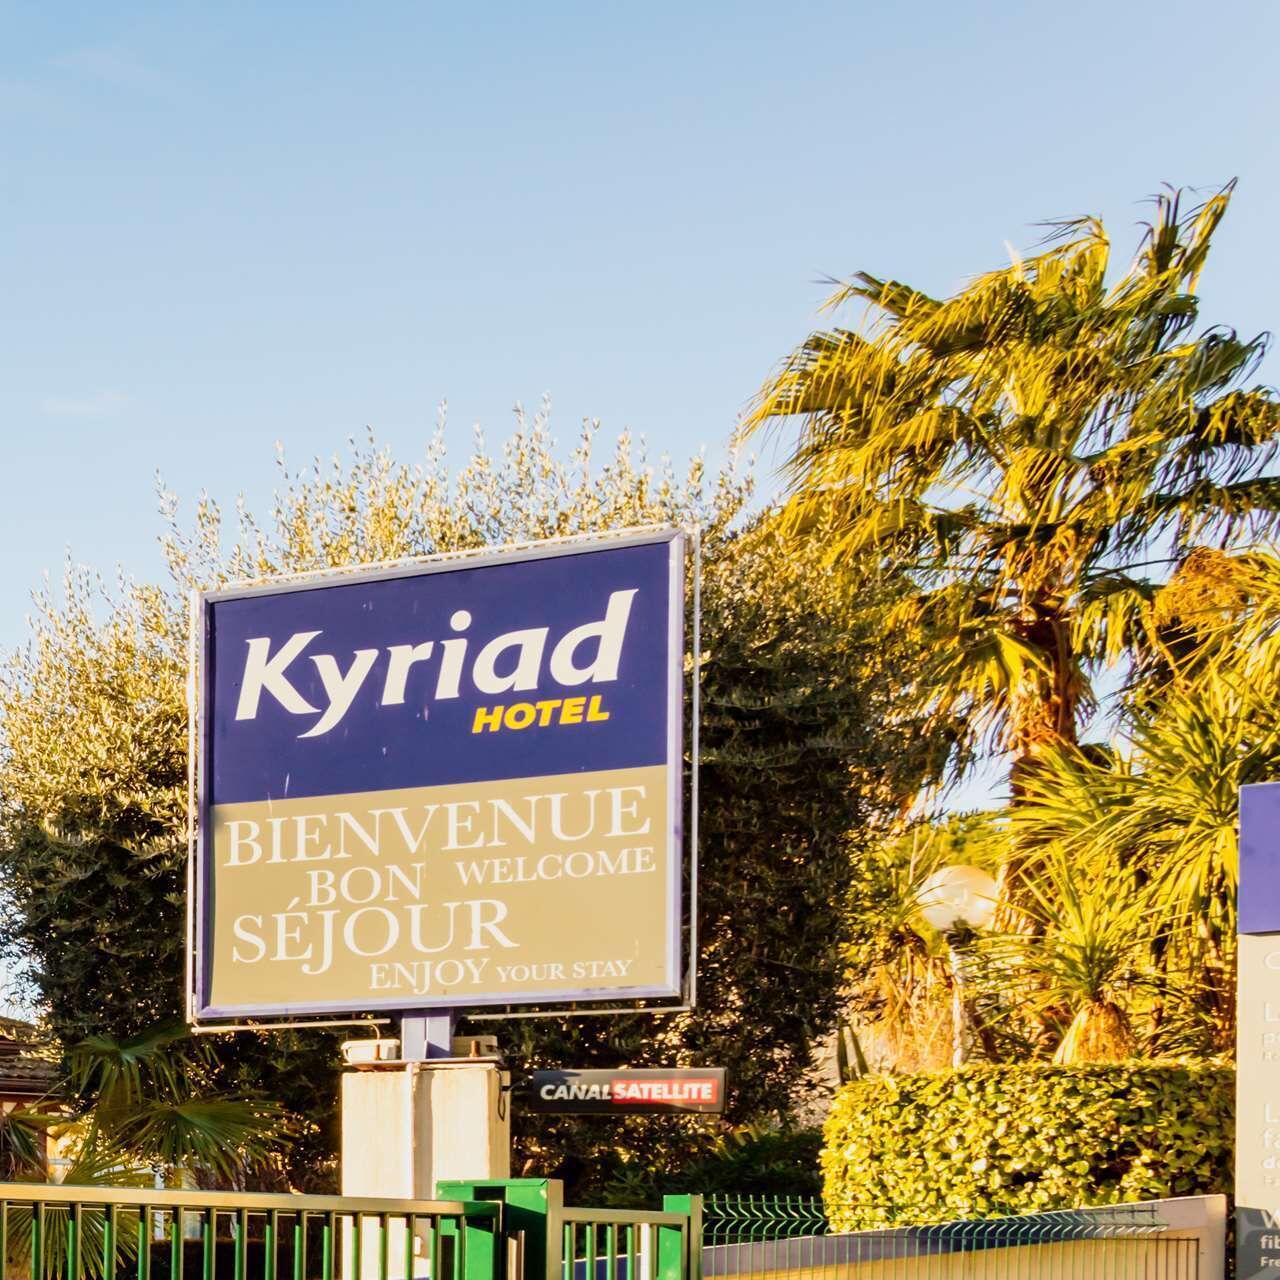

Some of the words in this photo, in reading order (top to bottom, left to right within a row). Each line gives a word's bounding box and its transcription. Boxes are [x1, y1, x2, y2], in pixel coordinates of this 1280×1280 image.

[235, 588, 638, 738] Kyriad
[471, 695, 609, 734] HOTEL
[223, 785, 651, 866] BIENVENUE
[306, 863, 424, 907] BON
[456, 847, 656, 886] WELCOME
[232, 897, 519, 975] SÉJOUR
[369, 957, 490, 995] ENJOY
[496, 963, 566, 983] YOUR
[572, 960, 633, 980] STAY
